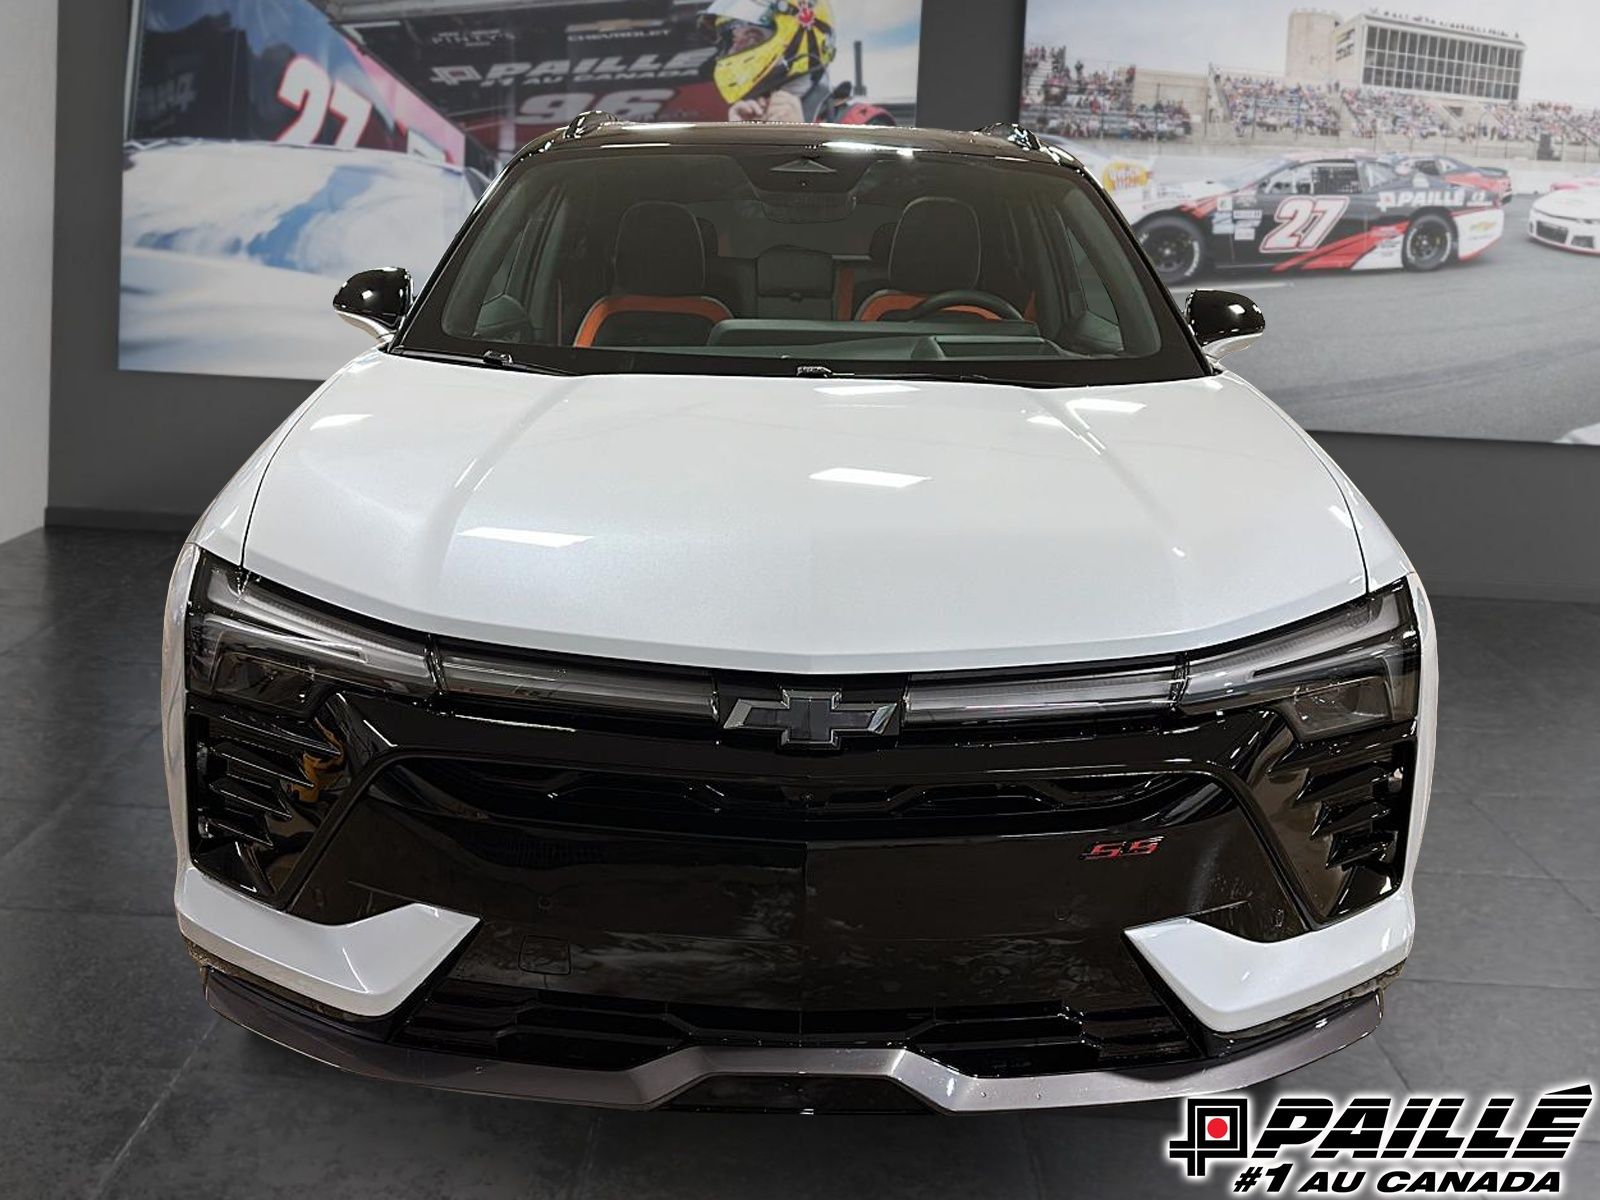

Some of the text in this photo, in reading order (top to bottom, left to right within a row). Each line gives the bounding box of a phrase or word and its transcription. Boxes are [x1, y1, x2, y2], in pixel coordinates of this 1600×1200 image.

[522, 75, 564, 85] AU
[573, 68, 699, 83] CANADA
[275, 54, 373, 149] 27
[1259, 195, 1351, 254] 27
[1080, 836, 1164, 861] SS
